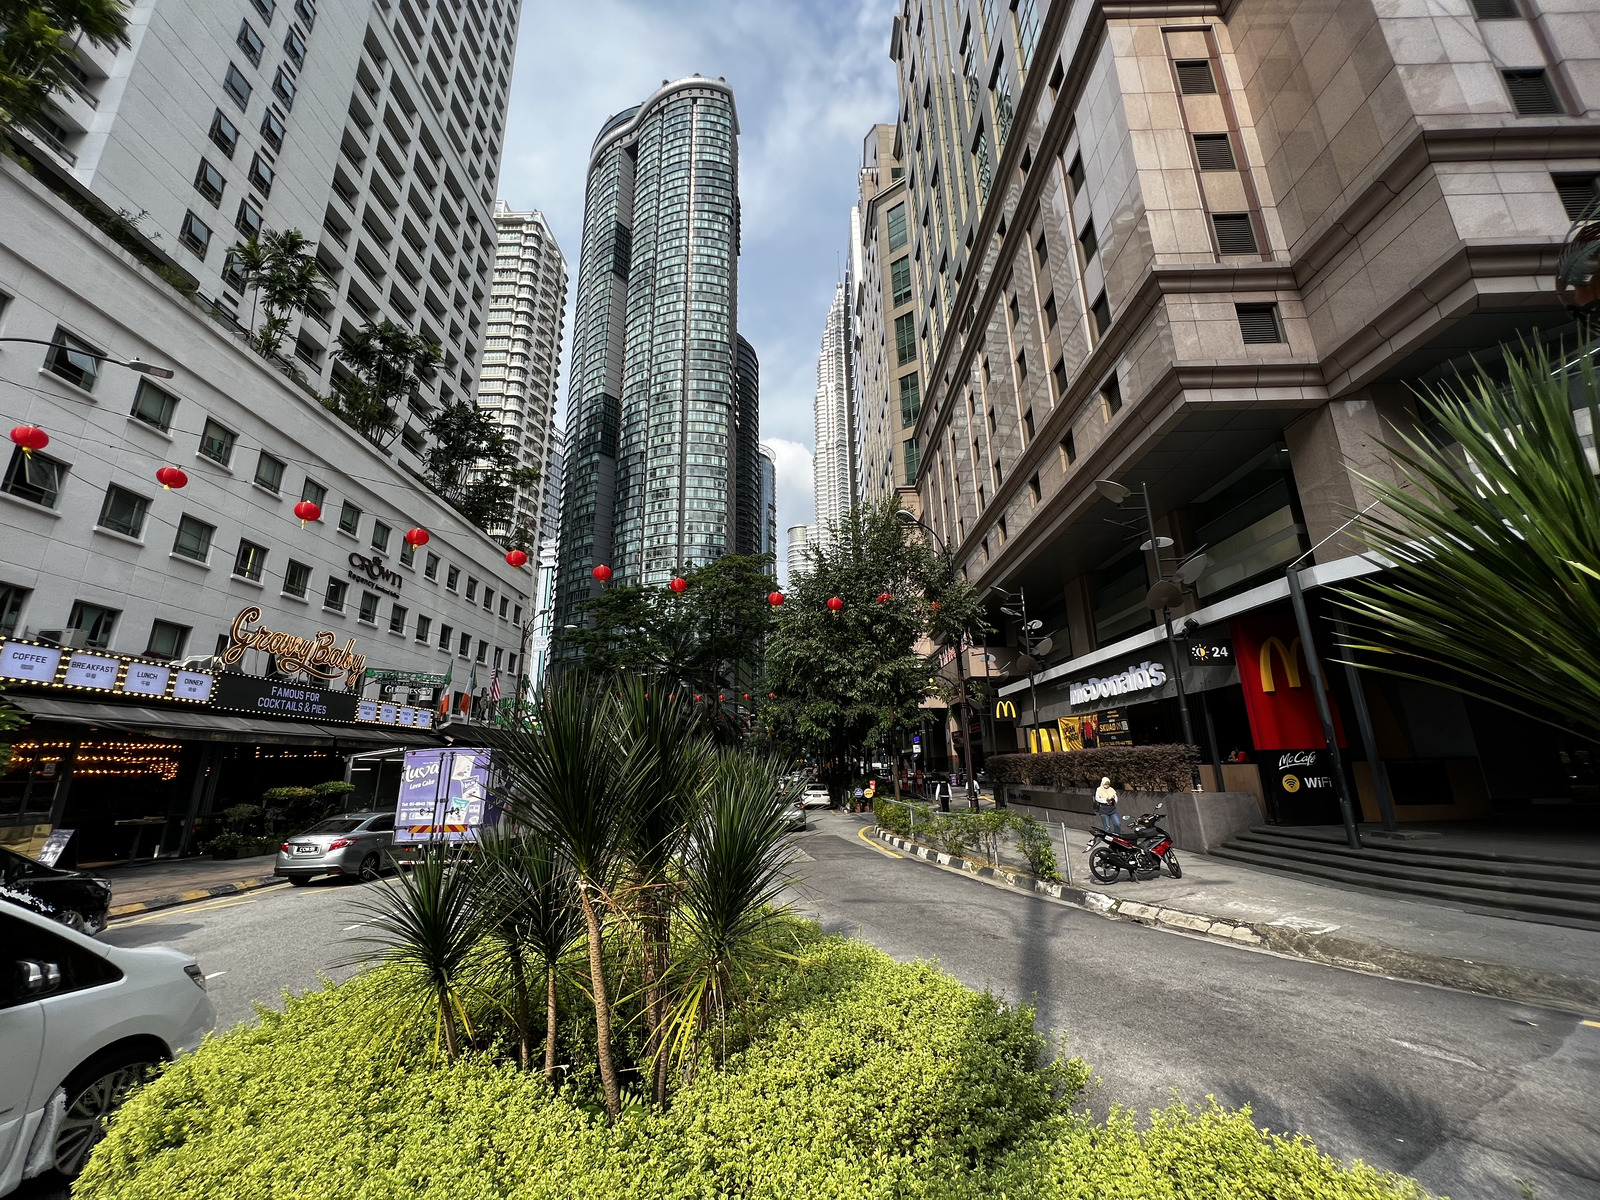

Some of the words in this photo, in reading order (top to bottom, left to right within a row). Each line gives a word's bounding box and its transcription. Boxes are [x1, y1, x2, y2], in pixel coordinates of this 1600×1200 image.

[12, 652, 48, 664] COFFEE
[1211, 646, 1229, 658] 24
[71, 661, 114, 673] BREAKFAST
[137, 671, 158, 680] LUNCH
[184, 678, 204, 687] DINNER
[1070, 661, 1166, 705] McDonald's
[271, 686, 305, 700] FAMOUS
[305, 691, 320, 702] FOR
[257, 697, 304, 712] COCKTAILS
[303, 702, 311, 713] &
[311, 704, 327, 715] PIES
[422, 779, 435, 787] Cake
[1304, 776, 1333, 788] WiFi
